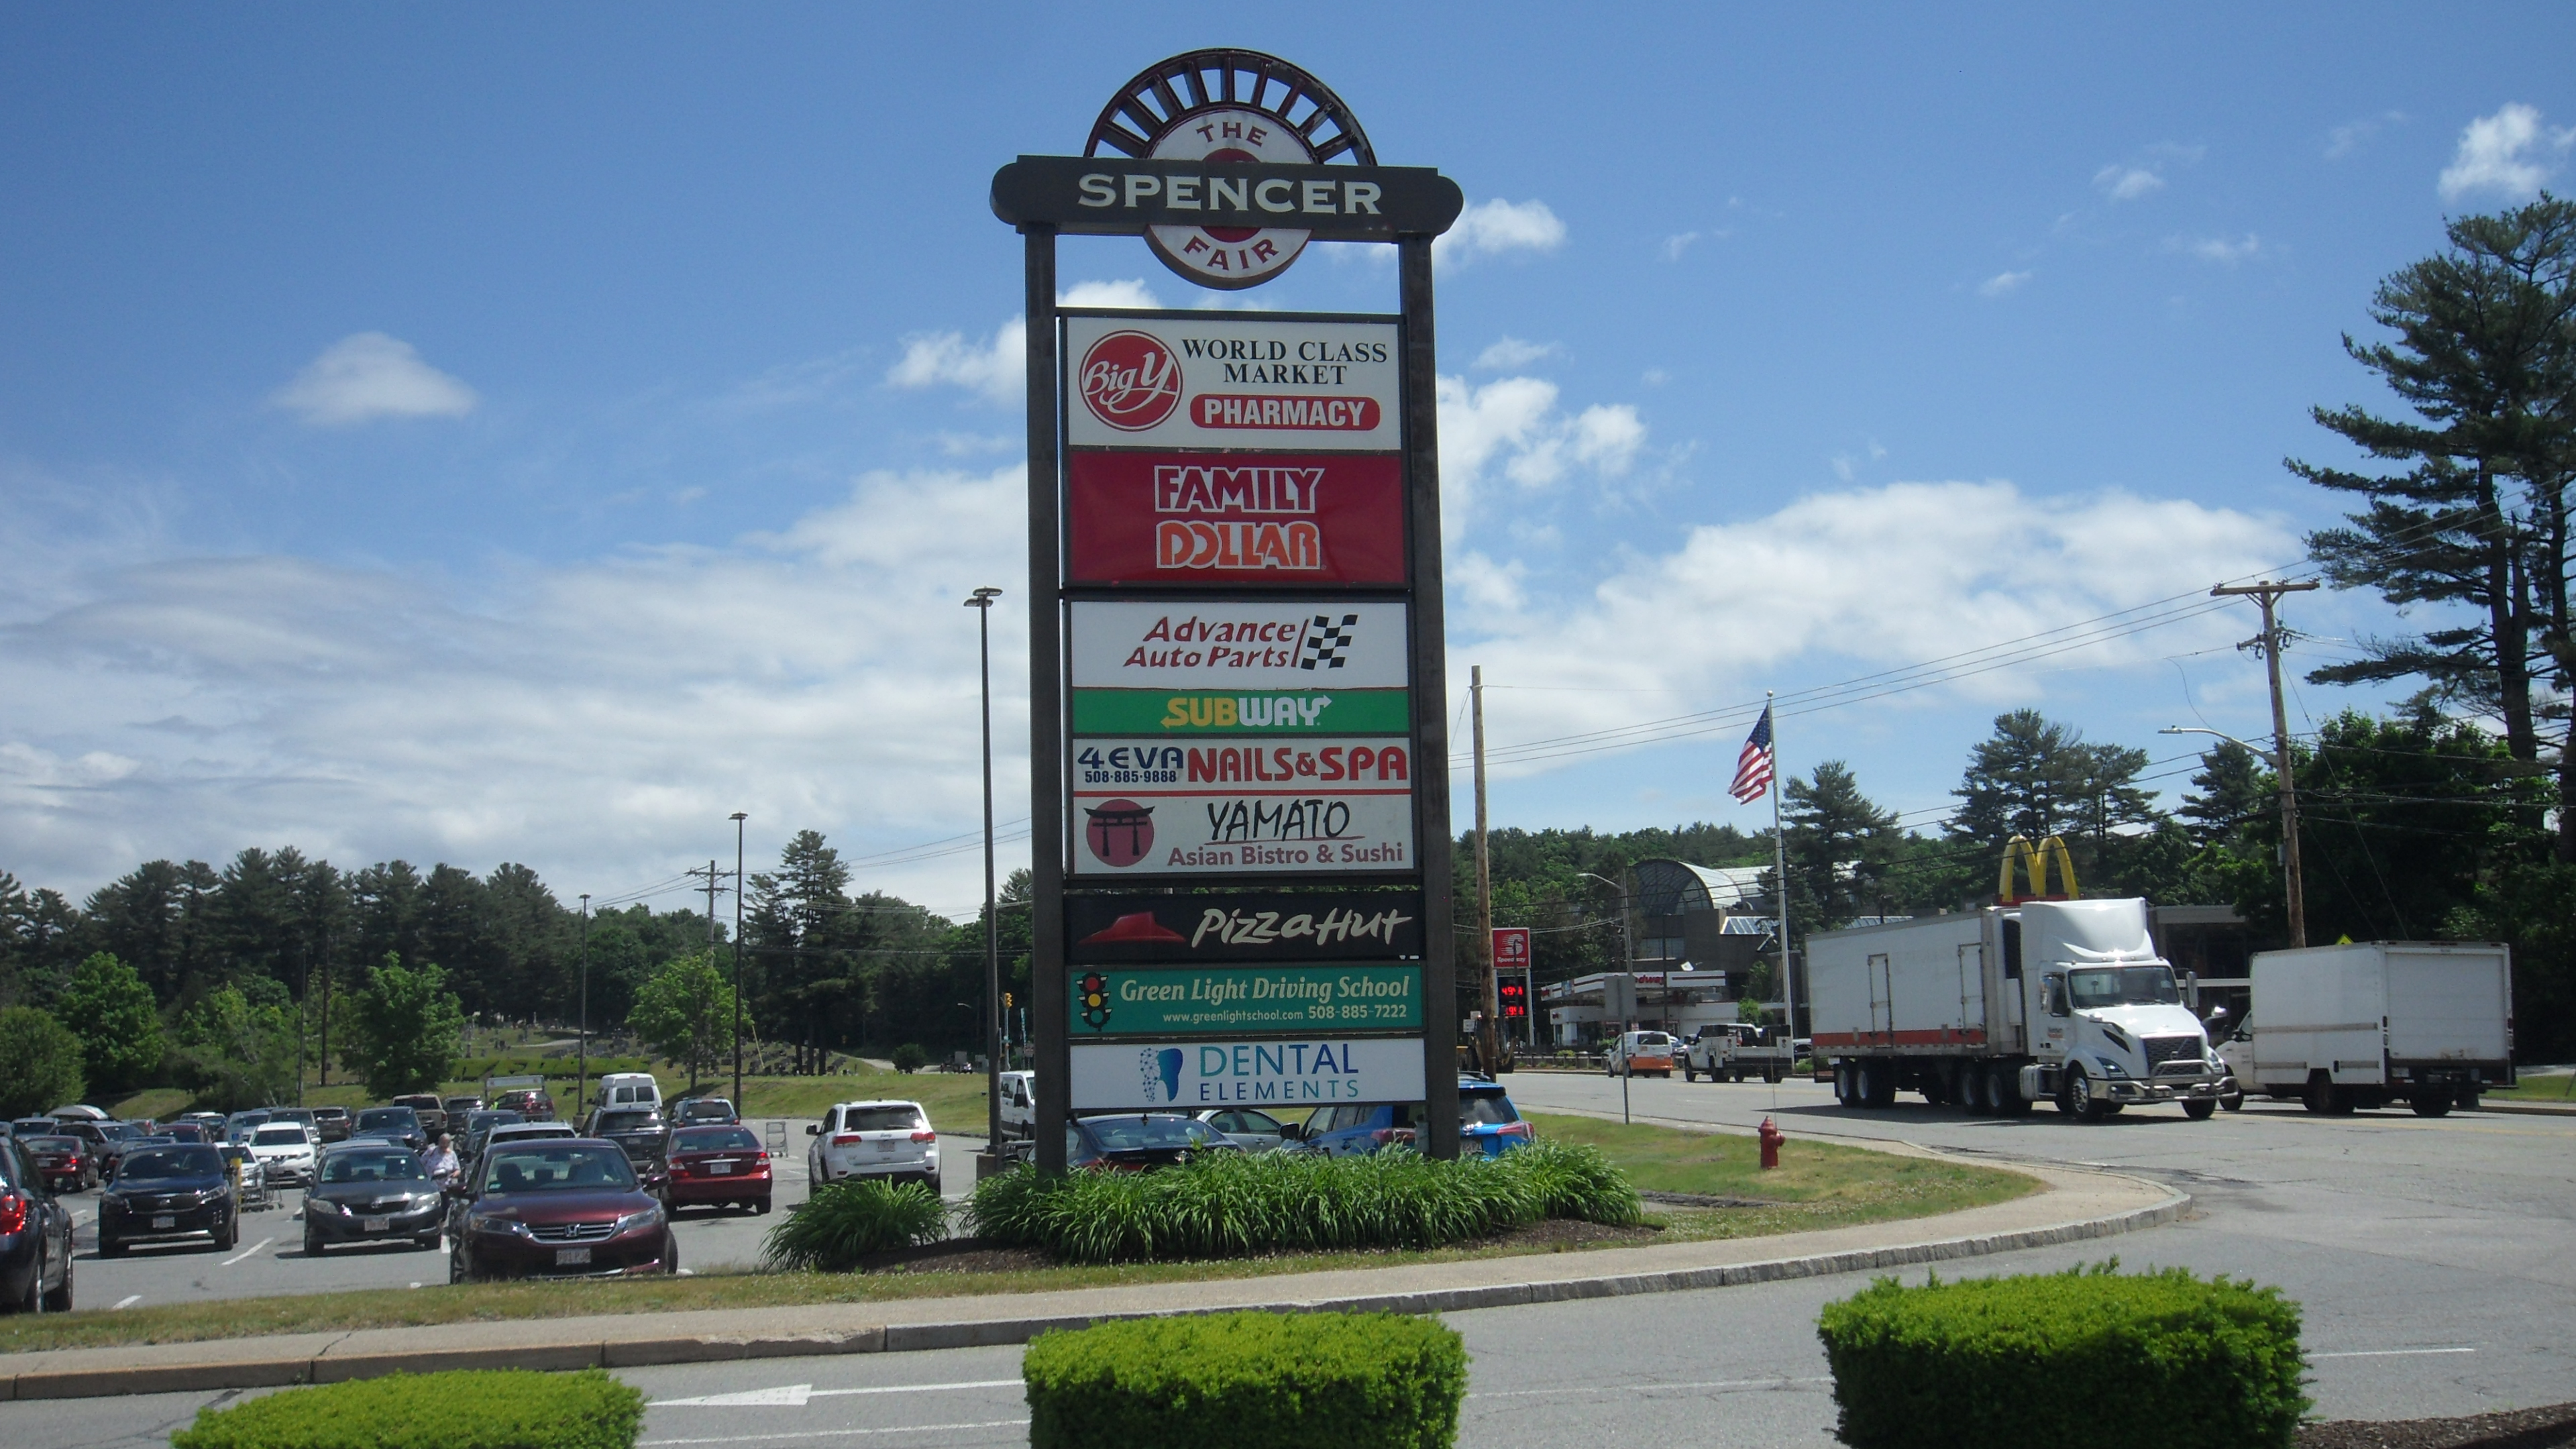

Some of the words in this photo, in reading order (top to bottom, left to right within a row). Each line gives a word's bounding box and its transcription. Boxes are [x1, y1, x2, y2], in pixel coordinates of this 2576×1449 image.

[1196, 121, 1268, 148] THE
[1077, 174, 1383, 215] SPENCER
[1183, 235, 1279, 270] FAIR
[1181, 339, 1287, 361] WORLD
[1298, 341, 1388, 363] CLASS
[1083, 360, 1136, 405] Big
[1108, 351, 1170, 413] Y
[1223, 363, 1347, 385] MARKET
[1204, 398, 1365, 427] PHARMACY
[1154, 465, 1325, 513] FAMILY
[1156, 520, 1321, 570] DOLLAR
[1143, 616, 1296, 642] Advance
[1123, 646, 1201, 668] Auto
[1207, 646, 1289, 668] Parts
[1160, 694, 1332, 729] SUBWAY
[1077, 747, 1183, 769] 4EVA
[1207, 799, 1350, 841] YAMATO
[1167, 846, 1233, 867] Asian
[1241, 845, 1309, 866] Bistro
[1316, 844, 1334, 863] &
[1341, 843, 1403, 863] Sushi
[1120, 979, 1185, 1002] Green
[1191, 978, 1247, 1005] Light
[1252, 977, 1332, 1004] Driving
[1338, 975, 1409, 998] School
[1163, 1010, 1303, 1024] www.greenlightschool.com
[1308, 1004, 1407, 1019] 508-885-7222
[1199, 1044, 1359, 1077] DENTAL
[1200, 1079, 1358, 1101] ELEMENTS
